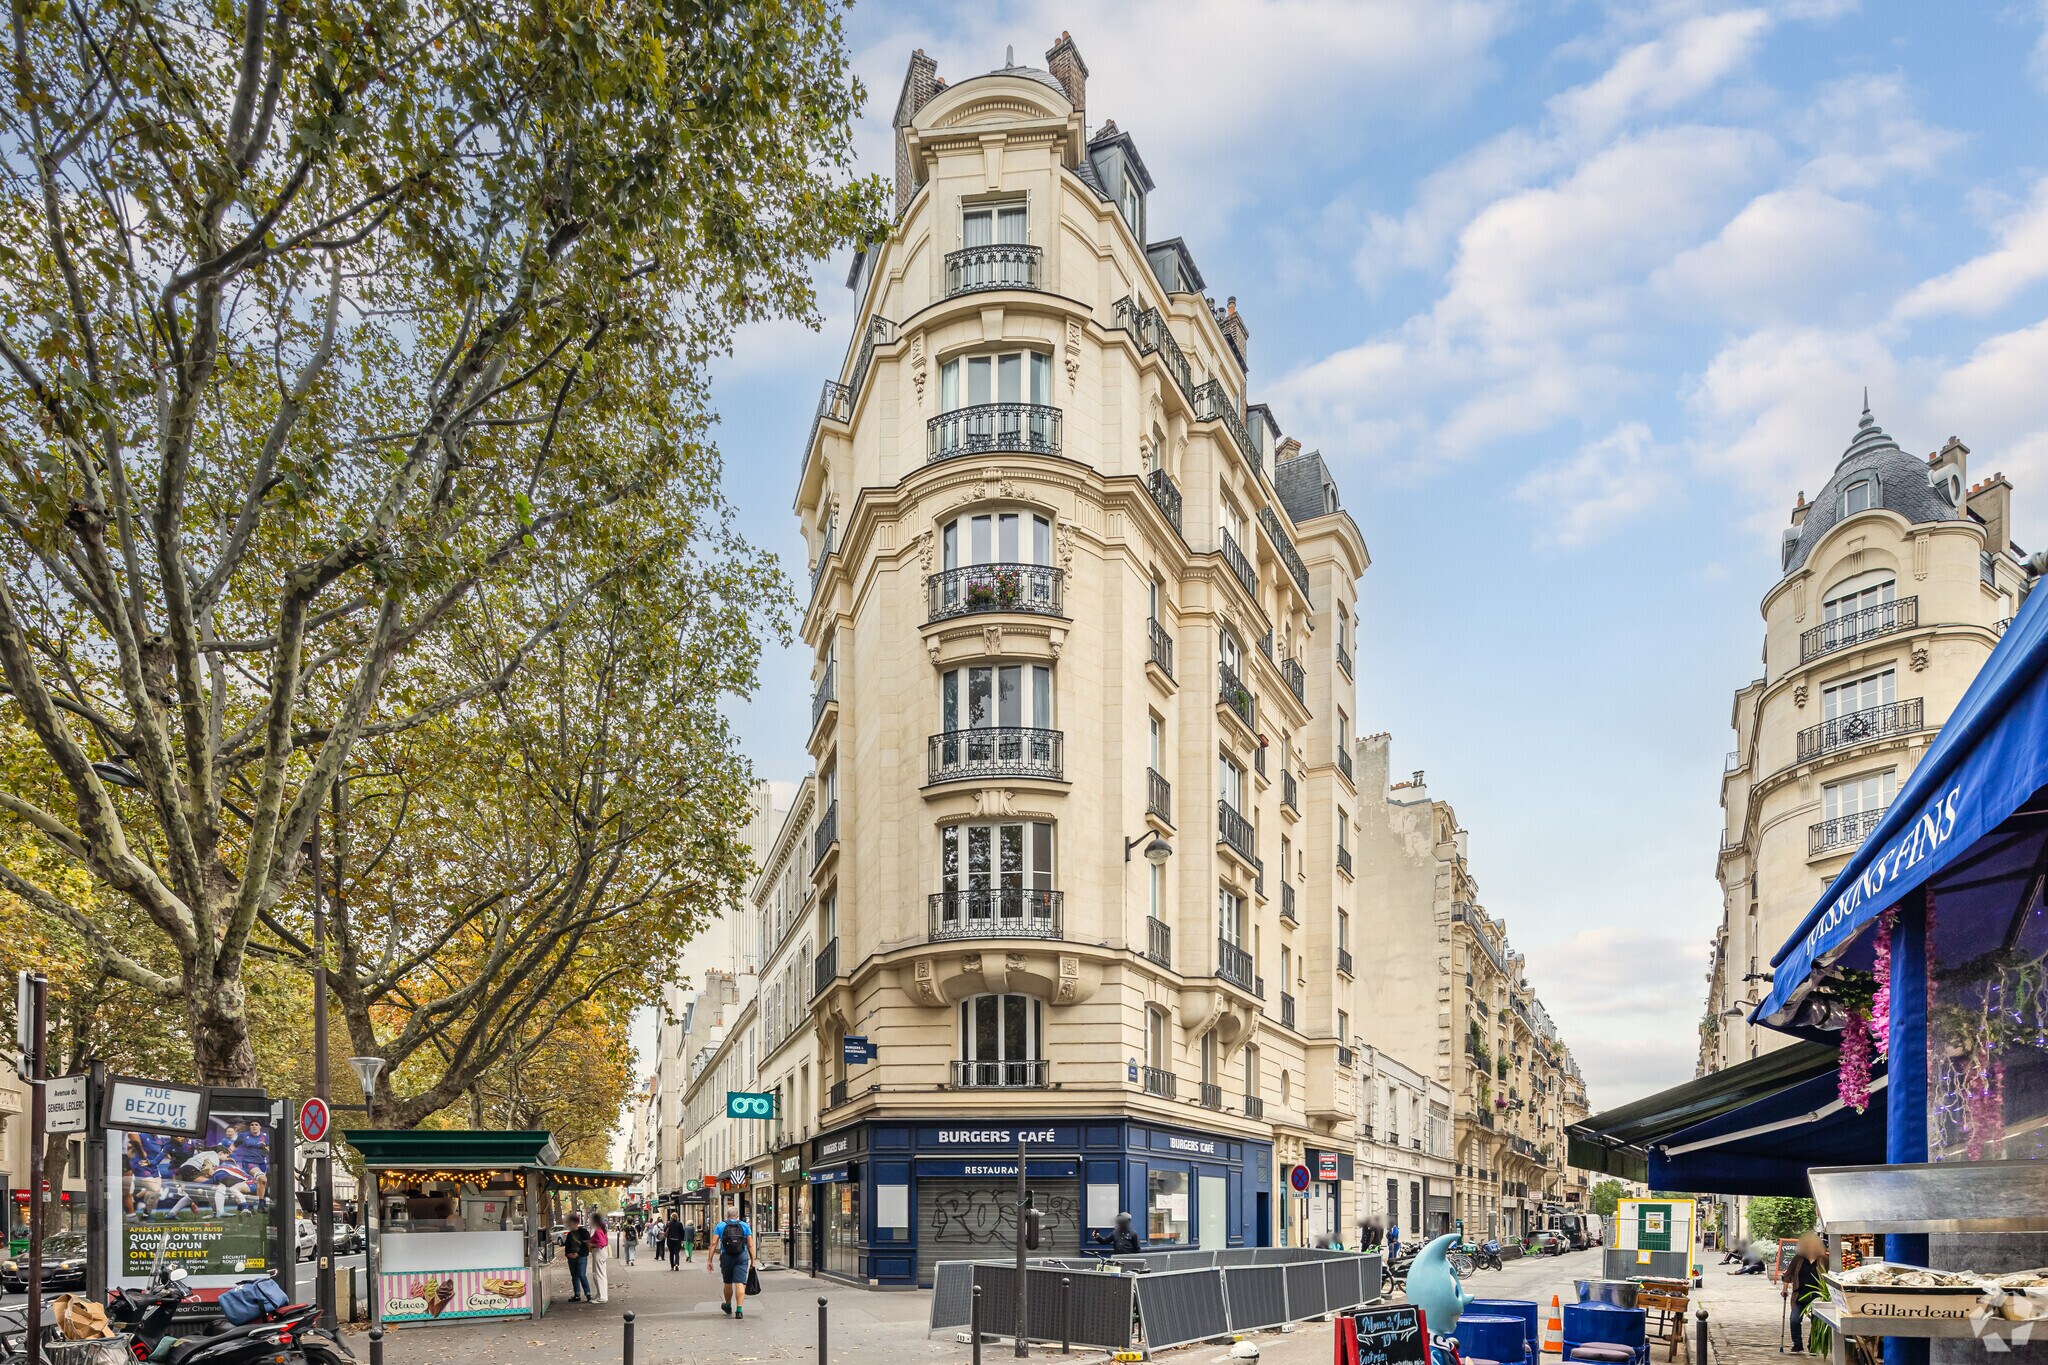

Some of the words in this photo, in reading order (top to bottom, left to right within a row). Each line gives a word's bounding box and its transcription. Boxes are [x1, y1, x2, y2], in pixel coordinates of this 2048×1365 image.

[1889, 784, 1961, 882] FINS
[144, 1088, 172, 1099] RUE
[48, 1102, 66, 1112] GENERAL
[66, 1101, 84, 1111] LECLERC
[125, 1098, 186, 1117] BEZOUT
[172, 1118, 187, 1128] 46
[938, 1131, 1010, 1143] BURGERS
[1018, 1128, 1055, 1142] CAFÉ
[823, 1142, 838, 1155] BURGERS
[838, 1138, 847, 1151] CAFÉ
[1170, 1137, 1199, 1152] BURGERS
[1200, 1142, 1214, 1154] CAFÉ
[130, 1242, 138, 1250] À
[390, 1301, 425, 1310] Glaces
[1860, 1302, 1965, 1318] Gillardeau
[1362, 1316, 1386, 1334] Menu
[1394, 1312, 1412, 1330] Jour
